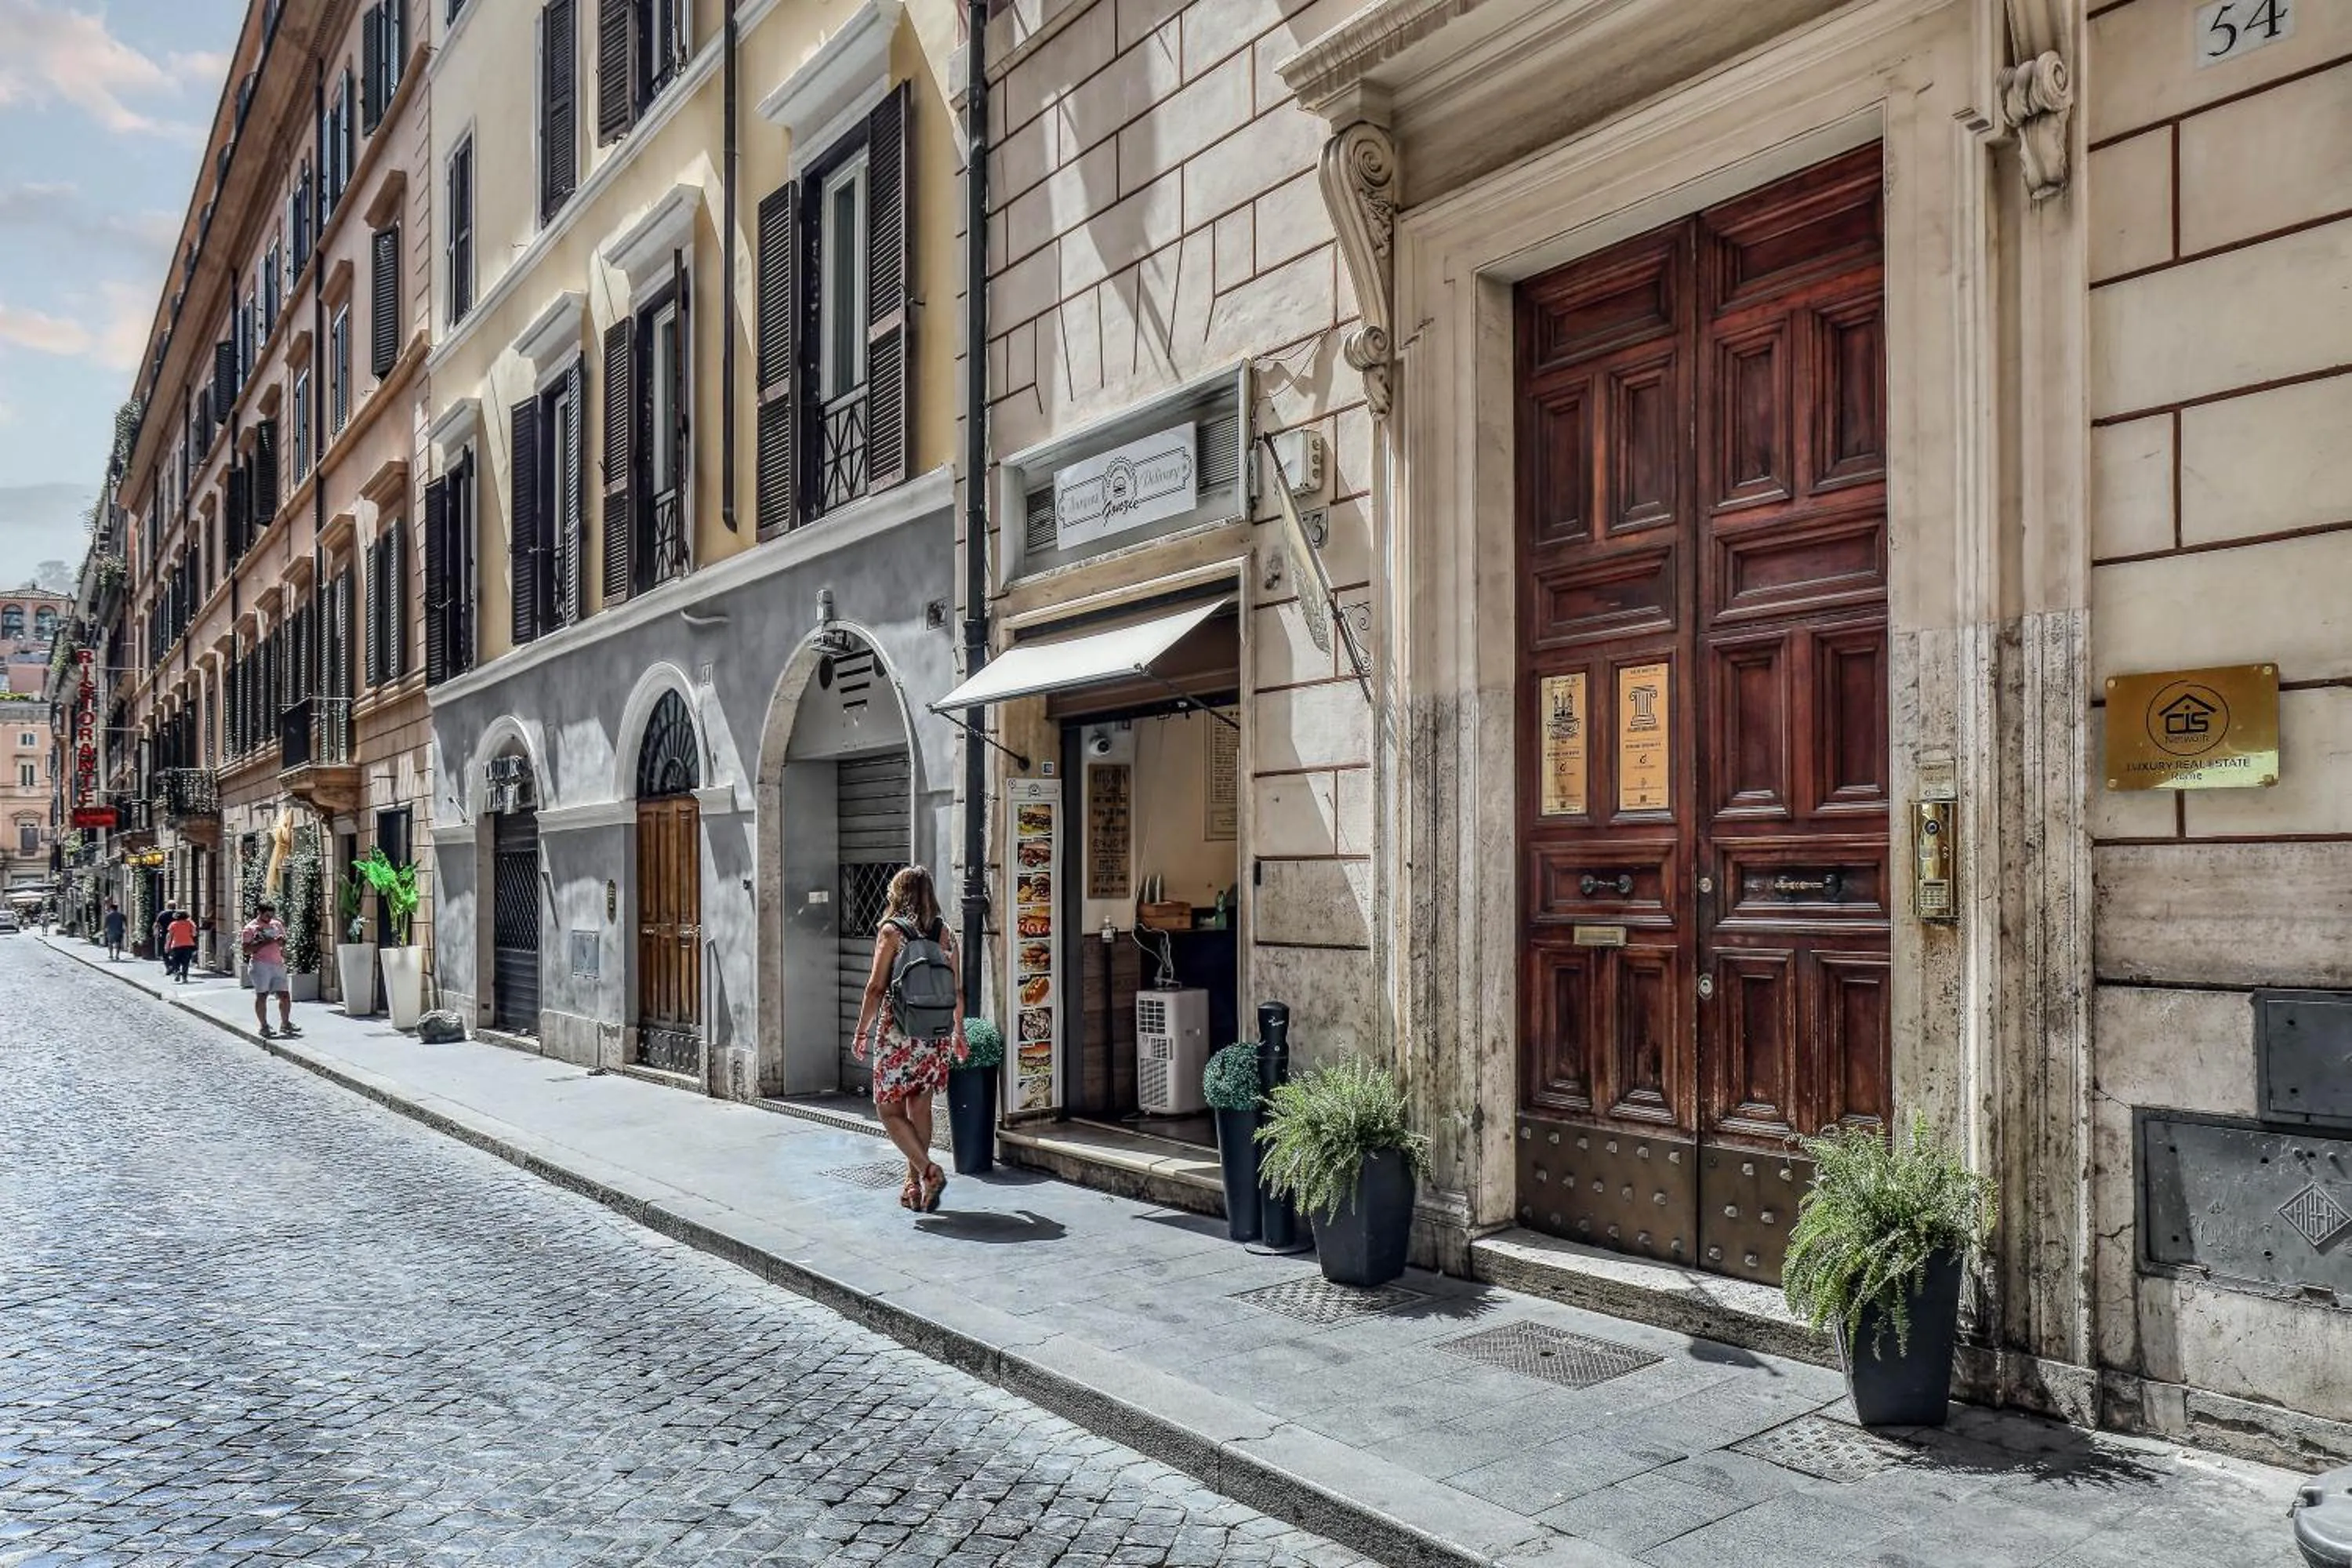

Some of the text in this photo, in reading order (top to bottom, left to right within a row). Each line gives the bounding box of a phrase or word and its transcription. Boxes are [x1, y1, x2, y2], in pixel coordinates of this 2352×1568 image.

[2208, 0, 2288, 57] 54
[77, 649, 95, 805] RISTORANTE
[2127, 760, 2172, 771] LUXURY
[2176, 760, 2205, 770] REAL
